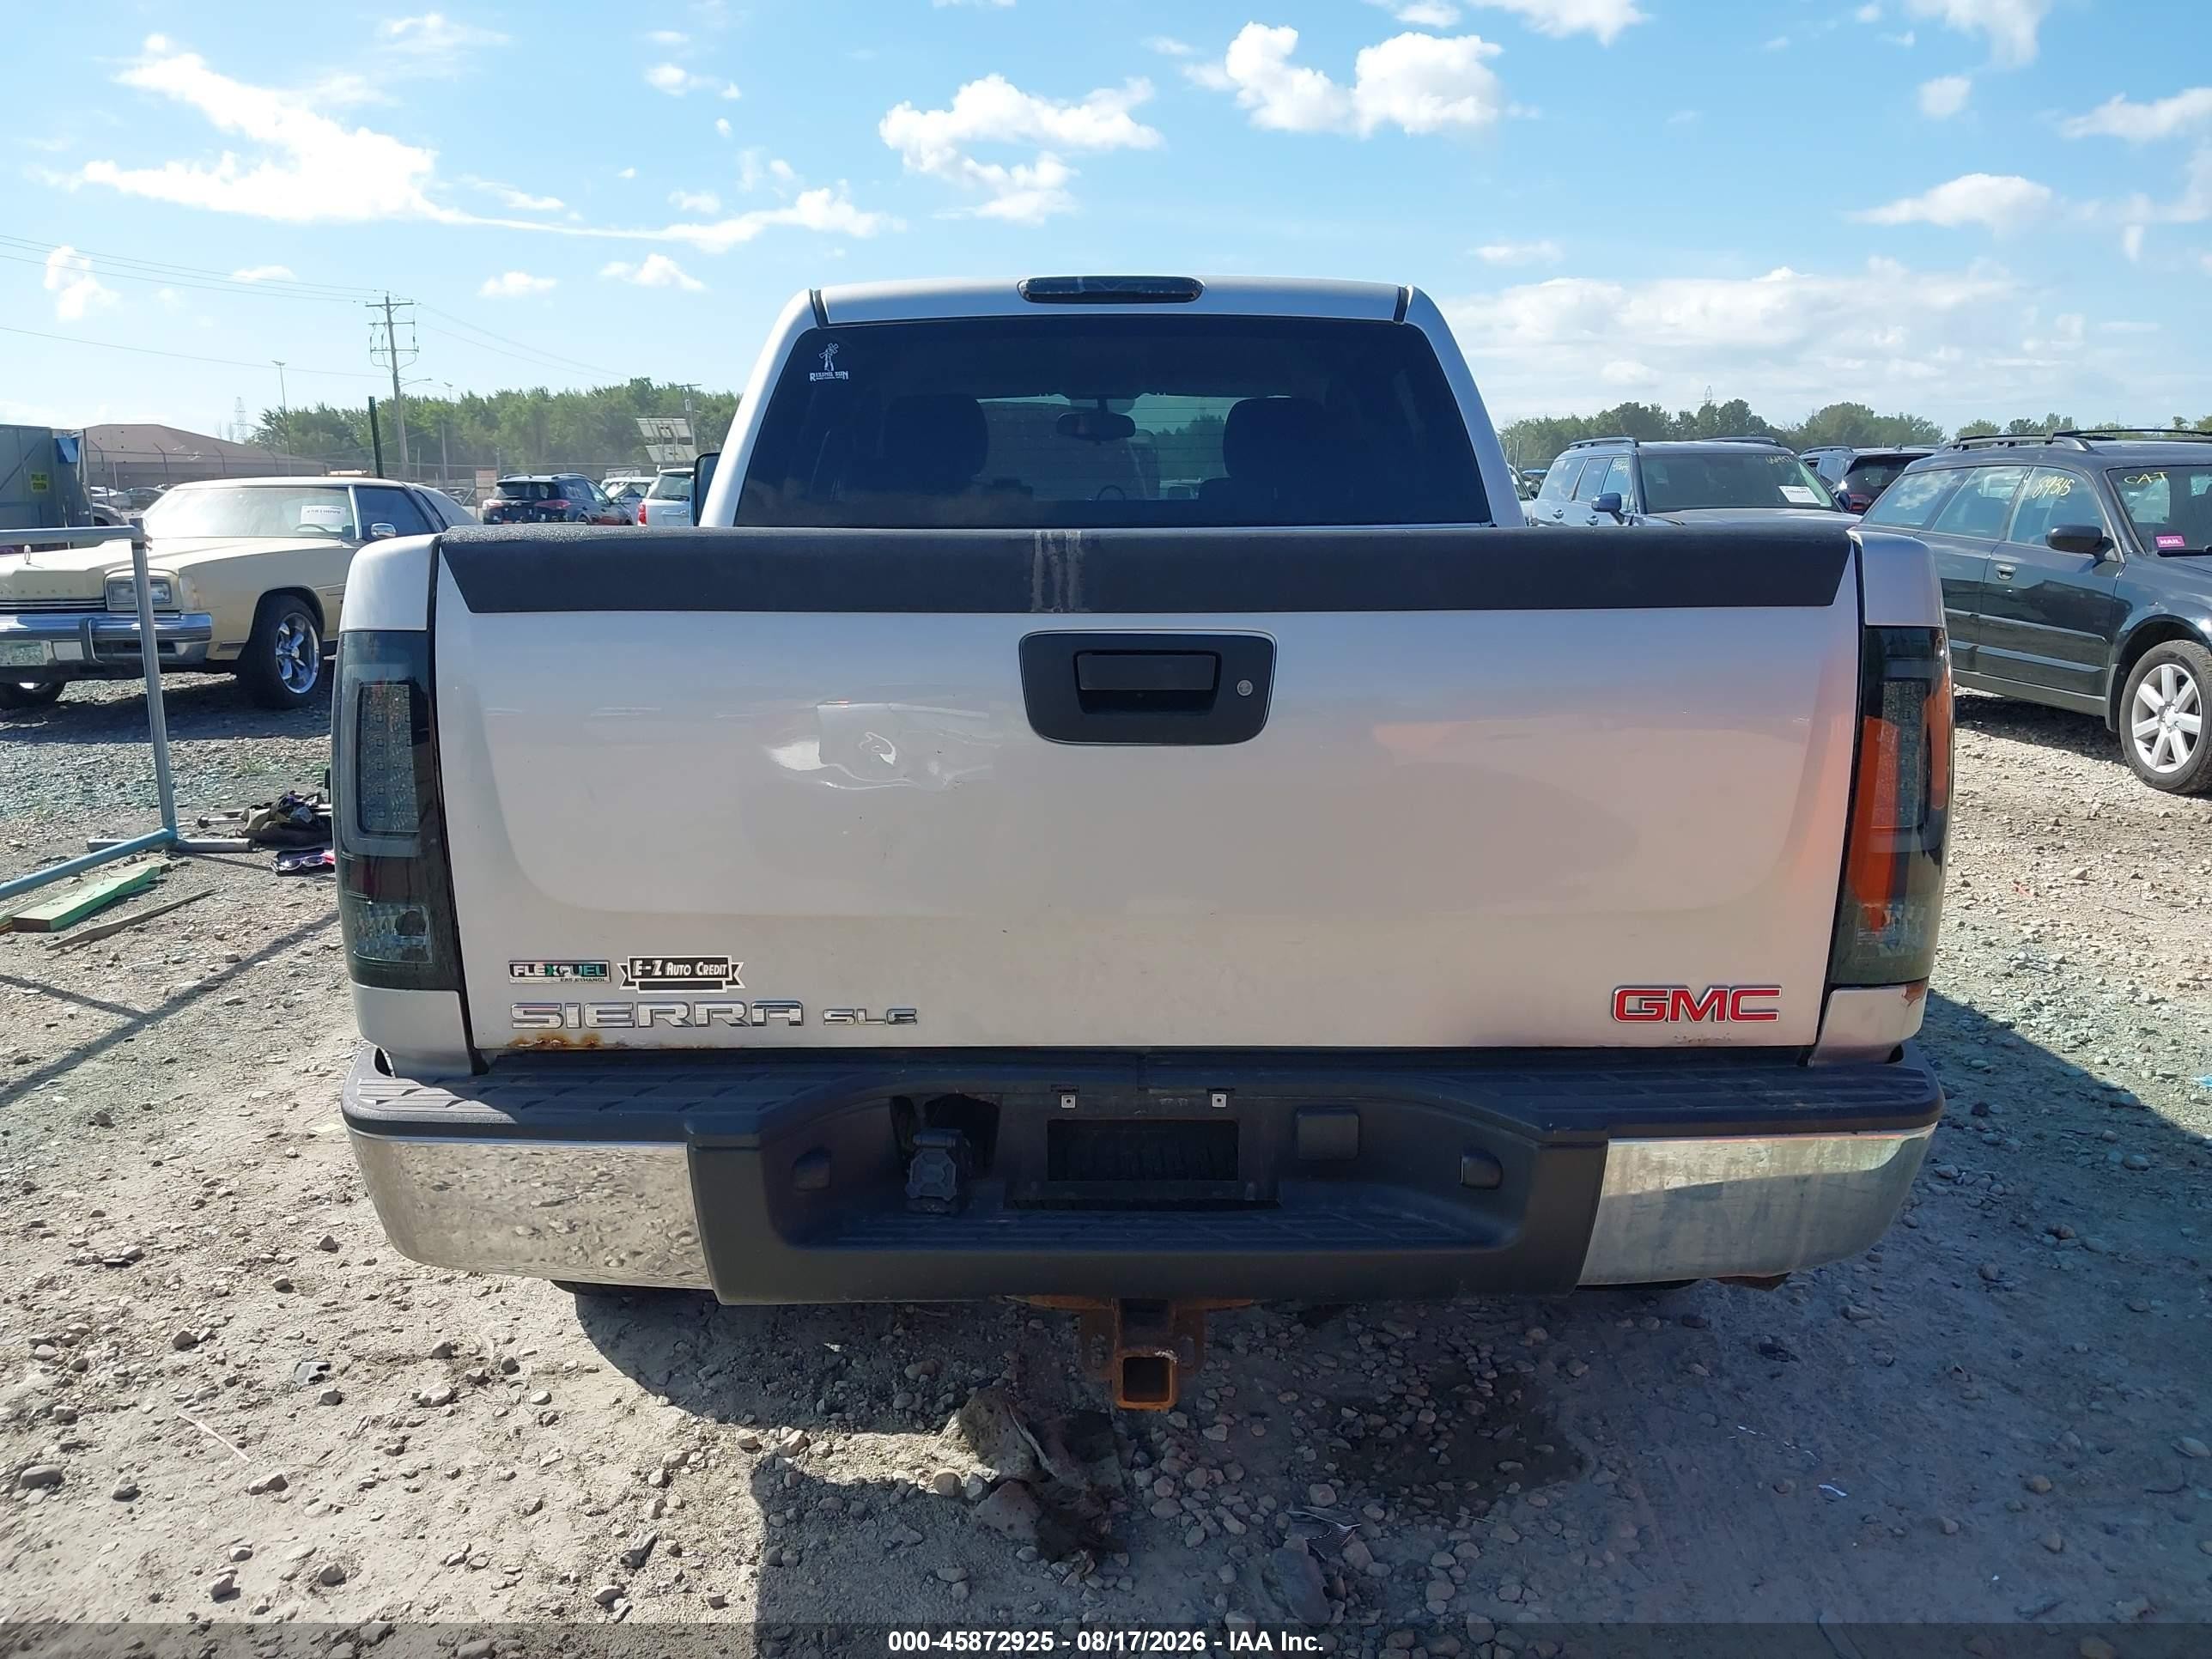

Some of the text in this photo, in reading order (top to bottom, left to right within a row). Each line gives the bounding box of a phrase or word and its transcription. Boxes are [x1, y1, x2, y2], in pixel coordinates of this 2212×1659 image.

[511, 1000, 918, 1030] SIERRA SLE
[1612, 986, 1782, 1023] GMC
